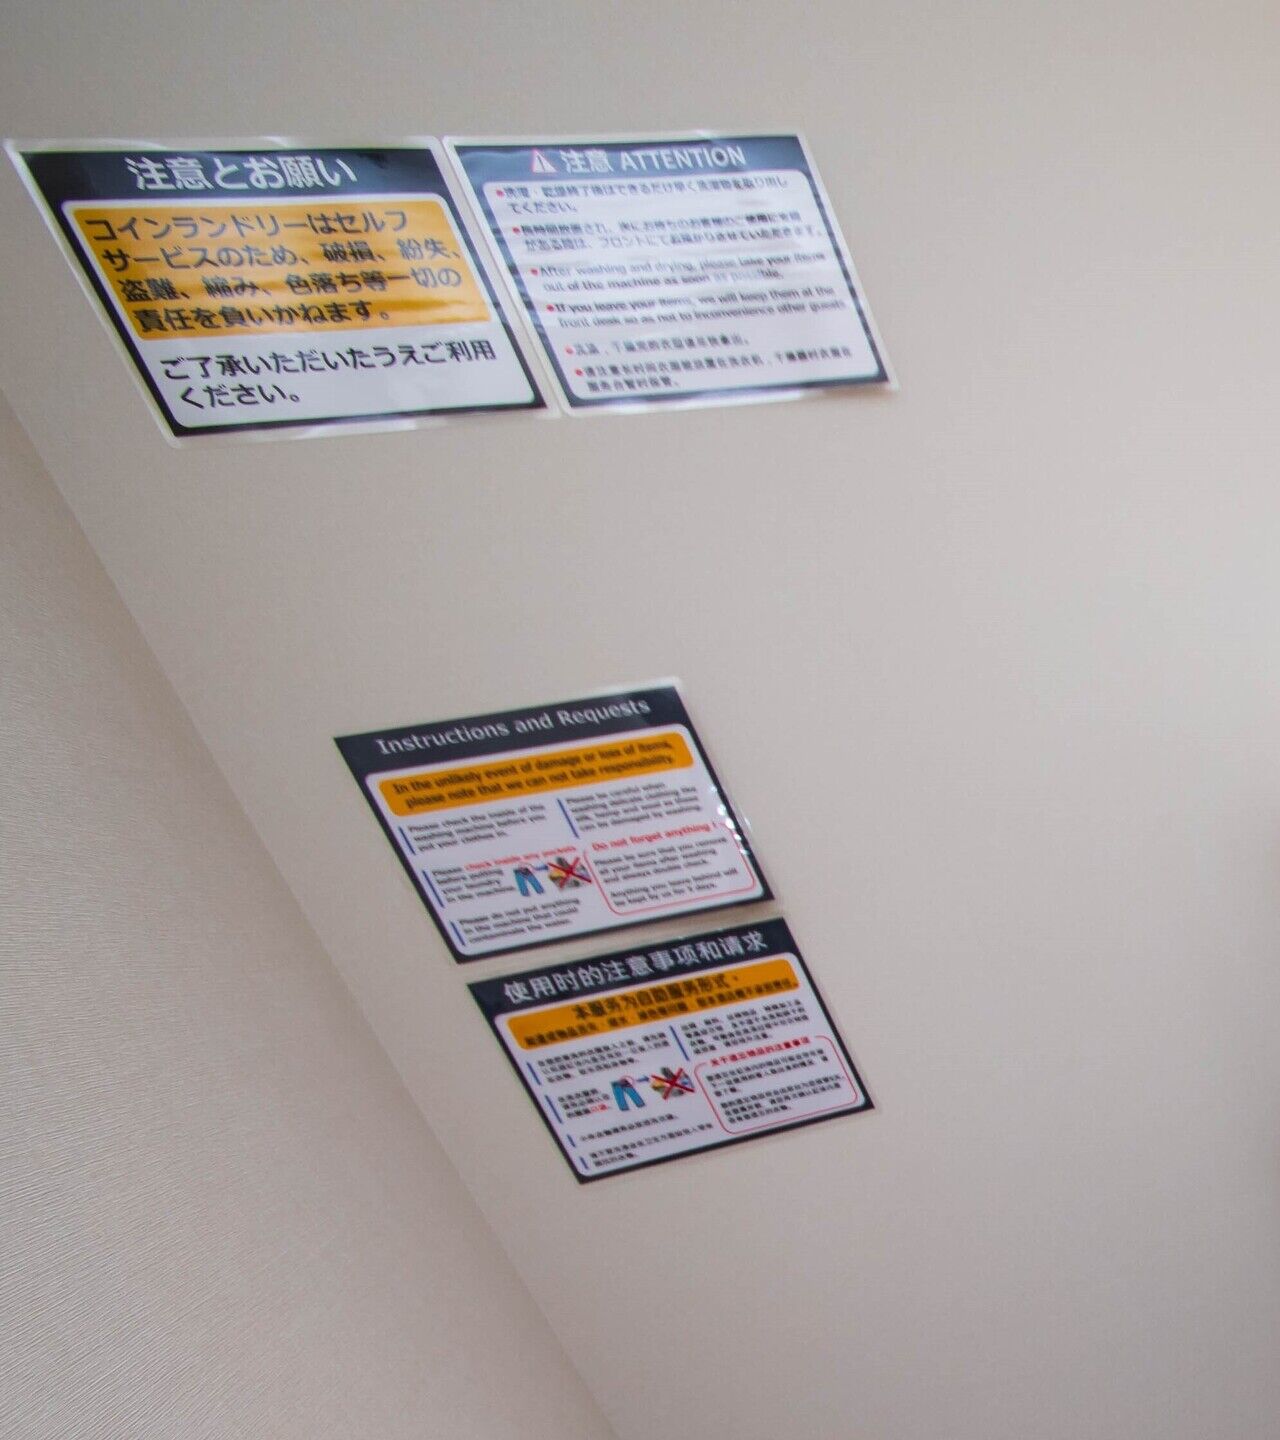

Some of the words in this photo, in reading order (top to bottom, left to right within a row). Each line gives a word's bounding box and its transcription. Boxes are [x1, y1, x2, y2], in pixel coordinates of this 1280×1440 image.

[127, 156, 358, 191] 注意とお願い
[560, 150, 613, 173] 注意
[621, 146, 747, 171] ATTENTION
[85, 210, 408, 242] コインランドリーはセルフ
[101, 240, 462, 271] サービスのため、破損、紛失、
[135, 300, 390, 333] 責任を負いかねます。
[161, 340, 497, 380] ご了承いただいたうえご利用
[180, 382, 302, 410] ください。
[376, 721, 510, 755] Instructions
[514, 712, 555, 733] and
[557, 699, 652, 727] Requests
[392, 782, 408, 794] In
[411, 780, 432, 791] the
[520, 762, 533, 772] of
[504, 931, 768, 1005] 使用时的注意事项和请求
